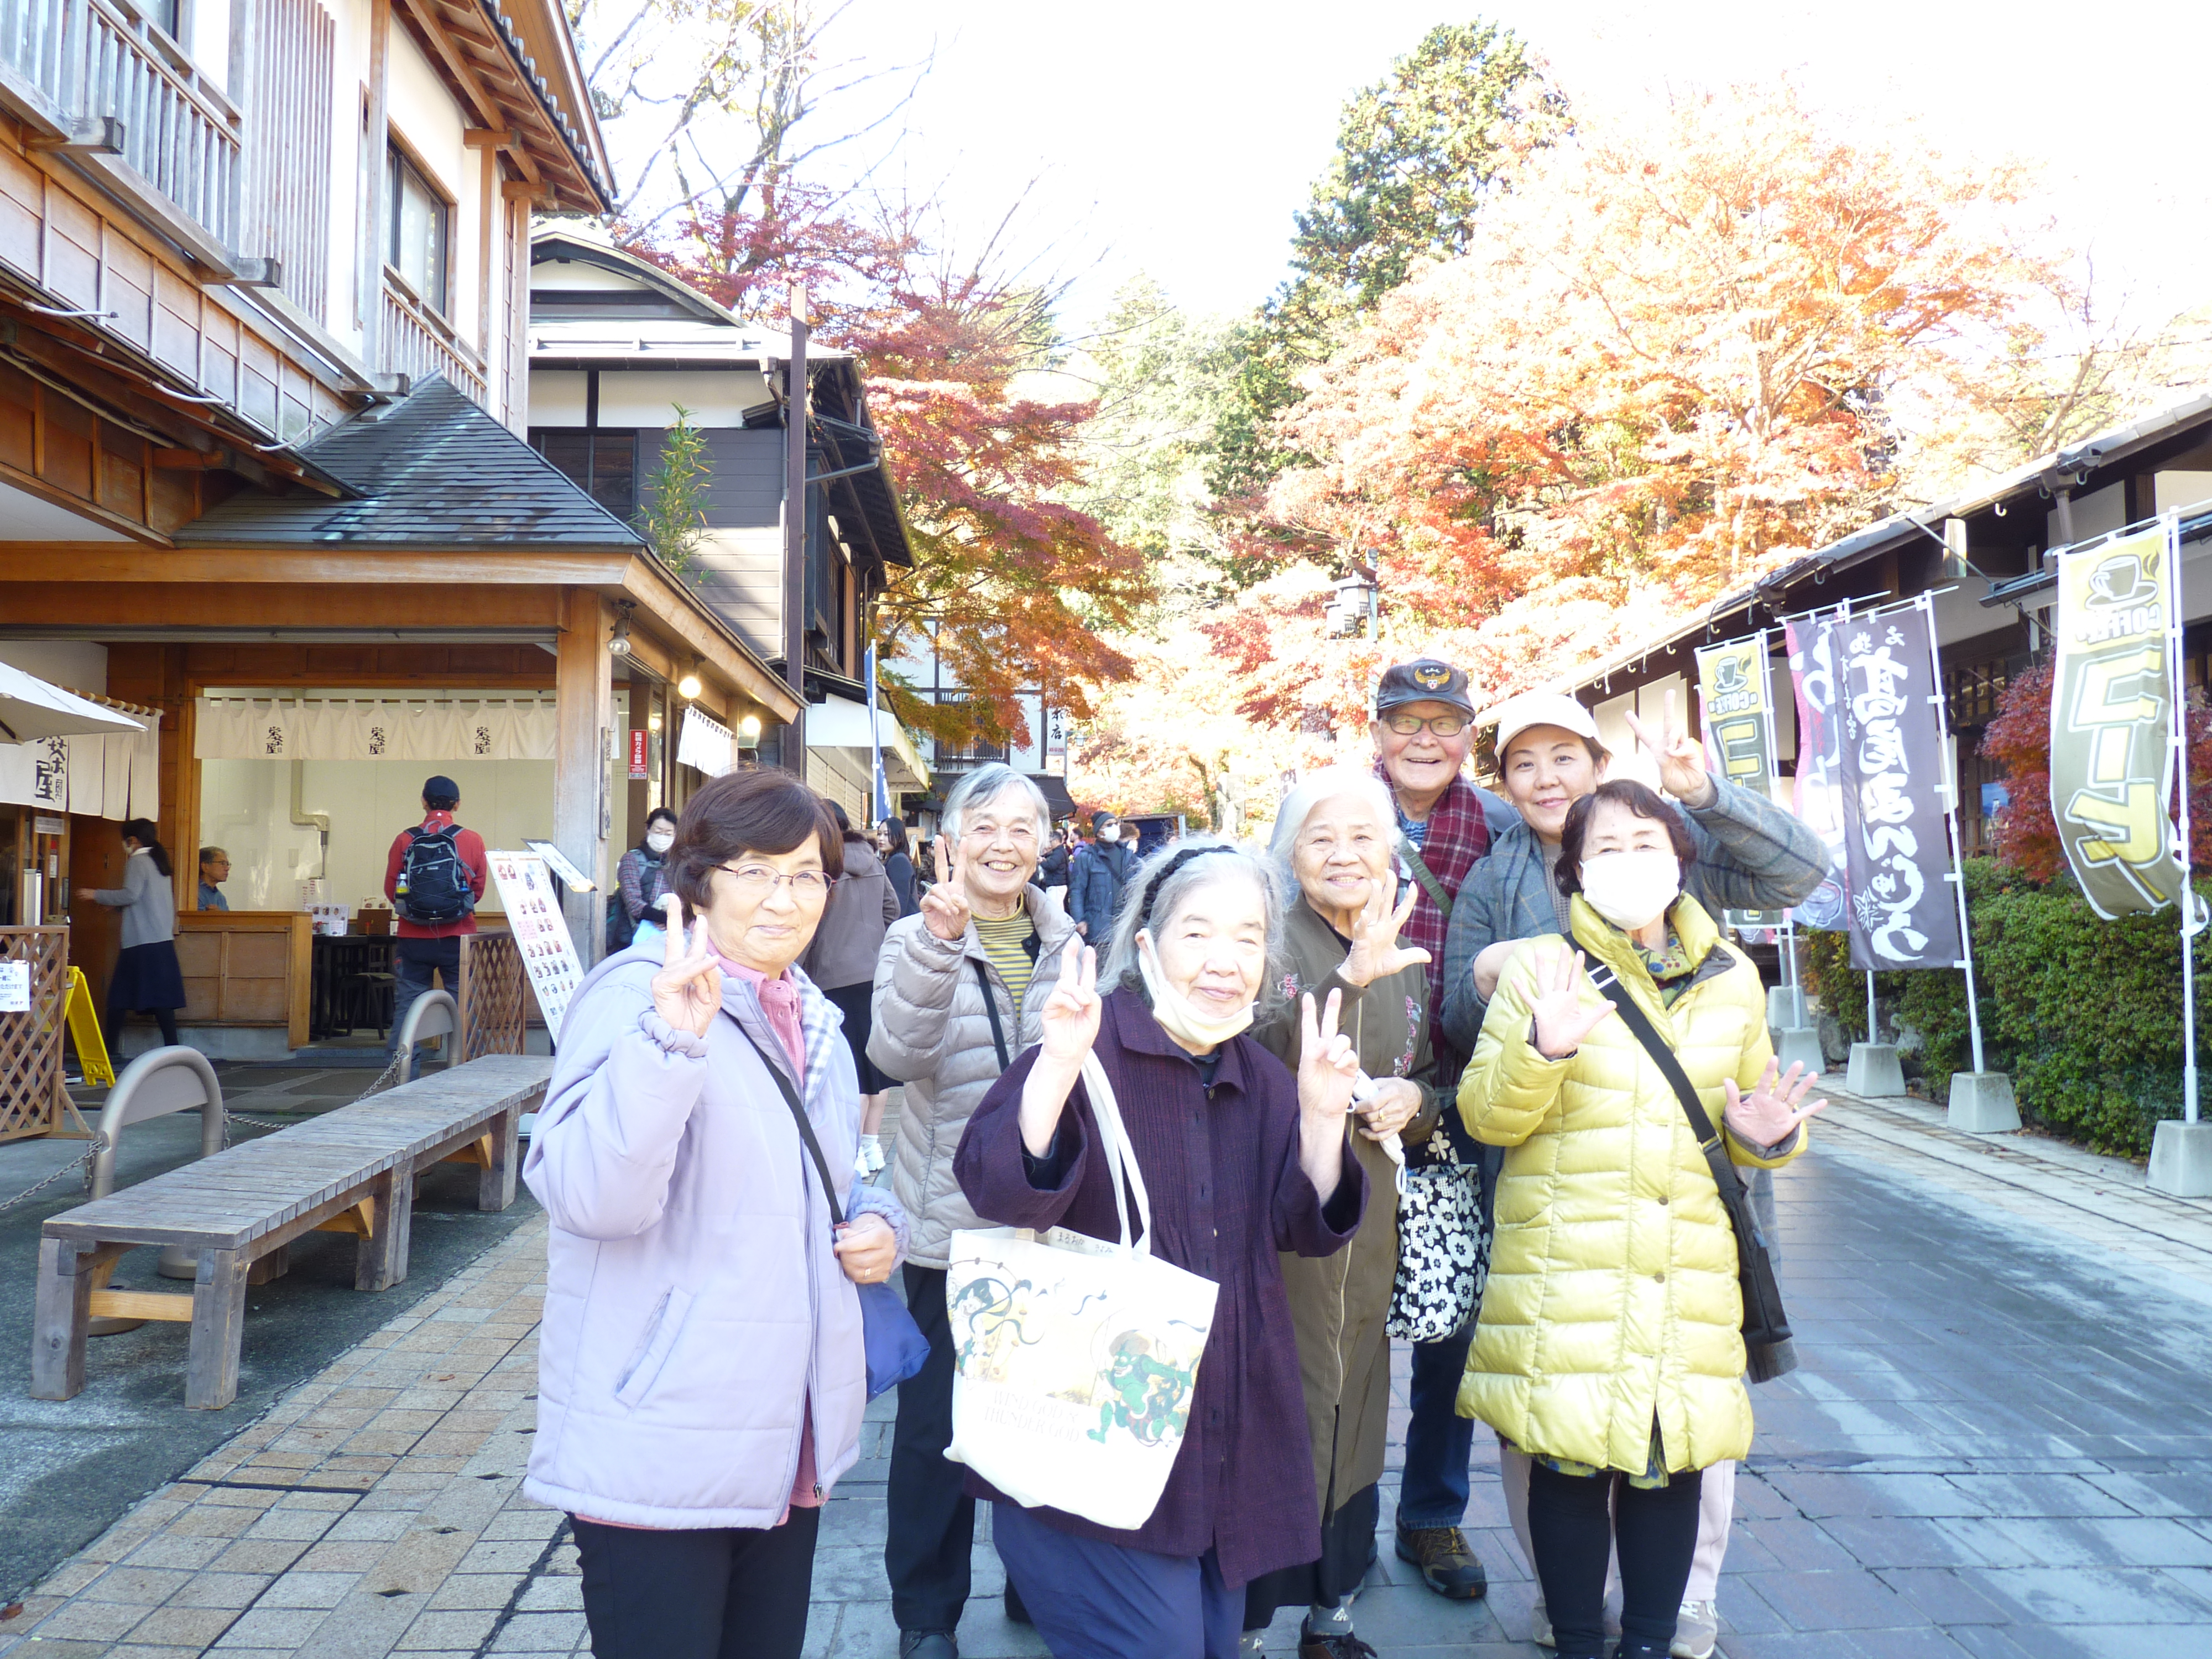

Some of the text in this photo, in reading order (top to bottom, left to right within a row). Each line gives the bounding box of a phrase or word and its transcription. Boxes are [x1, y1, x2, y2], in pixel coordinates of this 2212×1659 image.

[34, 736, 67, 803] 茶屋
[994, 1390, 1029, 1410] WIND
[1032, 1400, 1063, 1419] GOD
[984, 1406, 1080, 1442] THUNDER GOD
